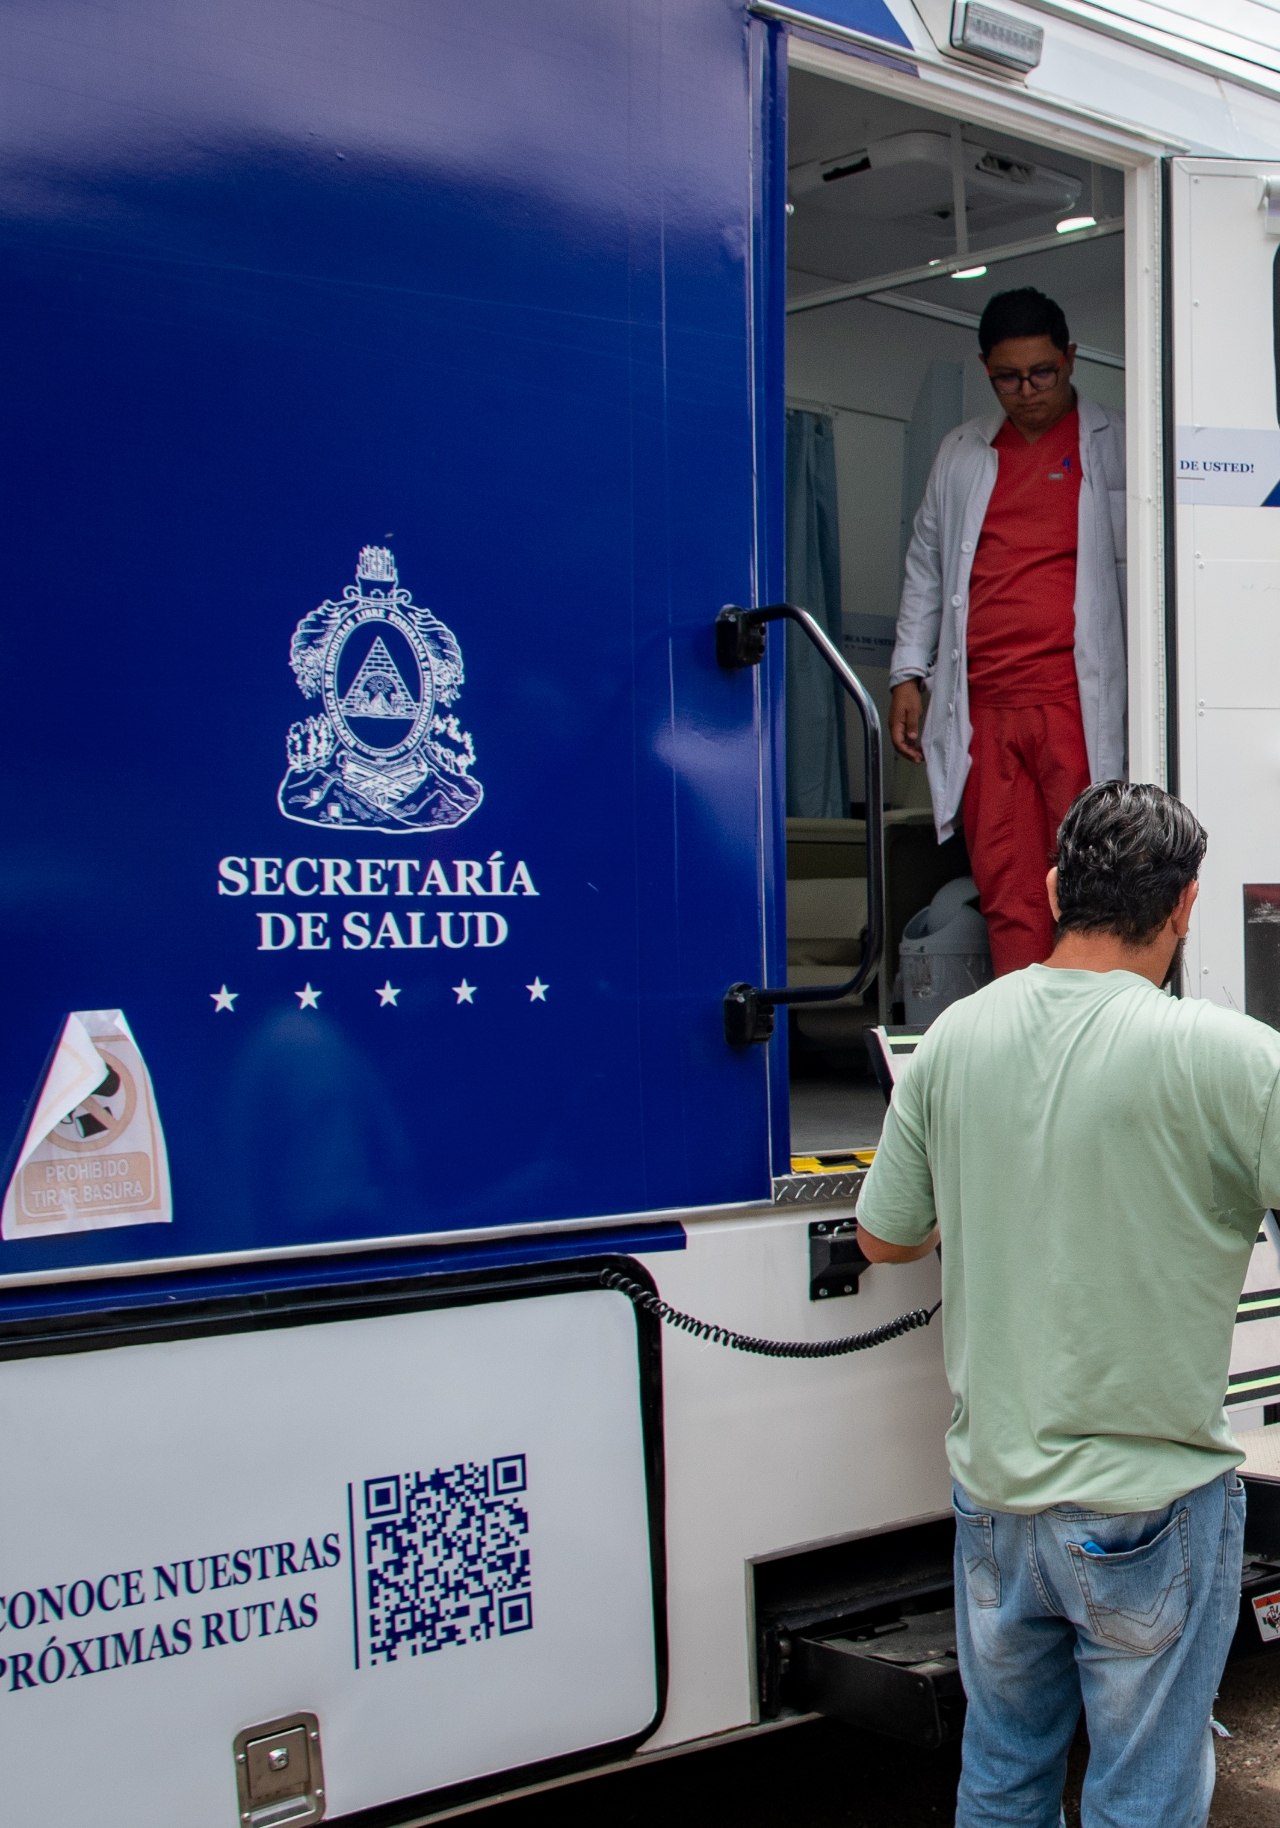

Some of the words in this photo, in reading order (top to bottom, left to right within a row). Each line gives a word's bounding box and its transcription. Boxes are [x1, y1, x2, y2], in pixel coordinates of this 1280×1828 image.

[1180, 460, 1199, 471] DE
[1202, 461, 1254, 473] USTED!
[217, 850, 540, 896] SECRETARÍA
[255, 912, 331, 950] DE
[342, 911, 509, 950] SALUD
[45, 1159, 129, 1183] PROHIBIDO
[31, 1188, 79, 1208] TIRAR
[83, 1180, 145, 1202] BASURA
[0, 1569, 146, 1633] ONOCE
[153, 1533, 342, 1601] NUESTRAS
[201, 1592, 319, 1650] RUTAS
